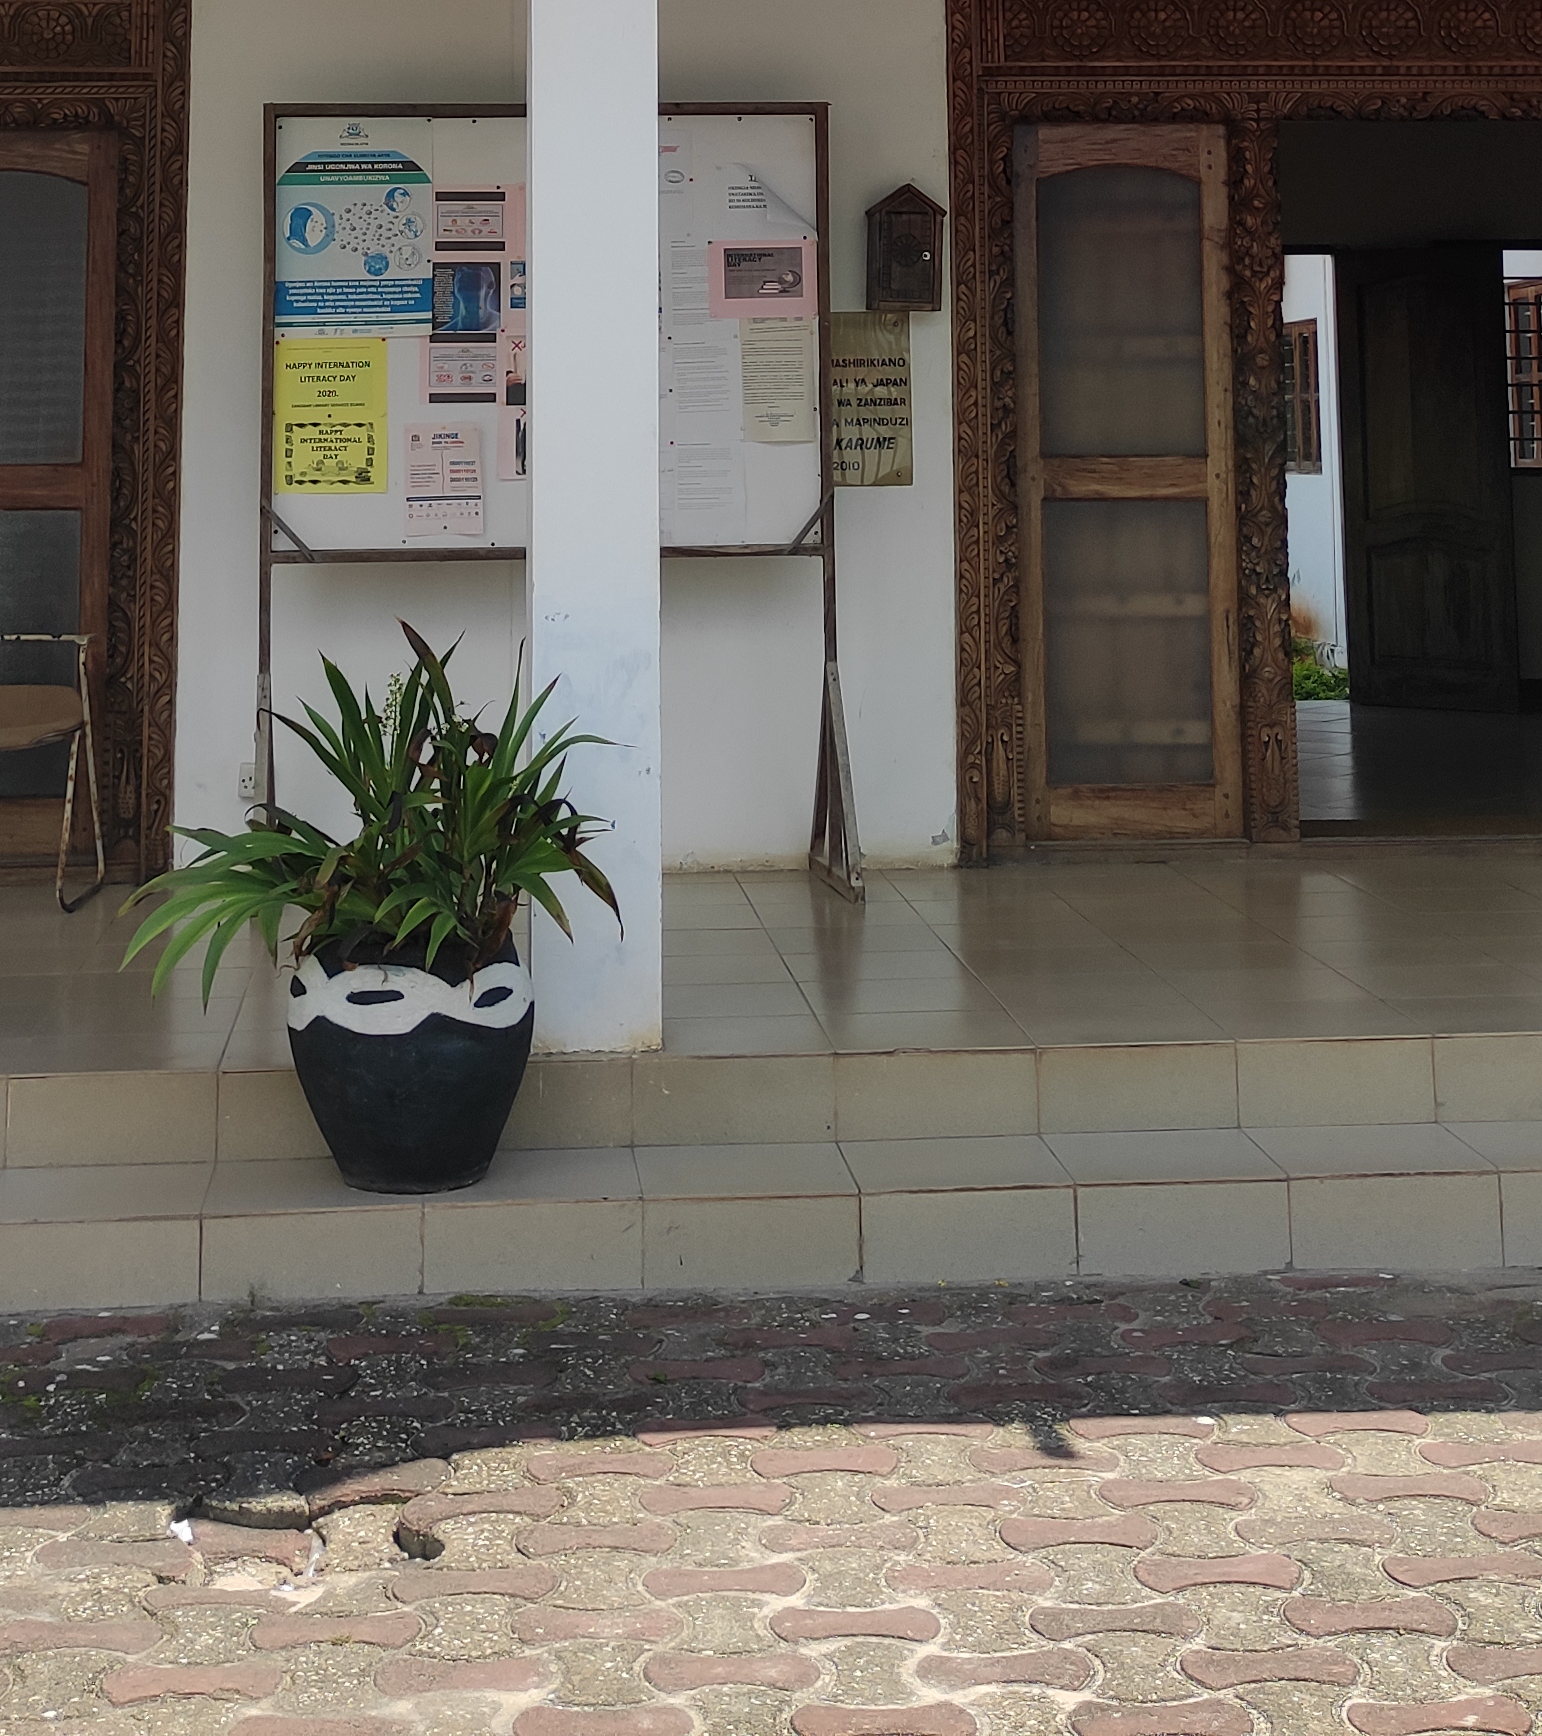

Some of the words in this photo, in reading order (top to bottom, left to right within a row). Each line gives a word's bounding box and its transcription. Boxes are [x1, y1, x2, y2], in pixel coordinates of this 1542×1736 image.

[831, 357, 905, 368] ASHIRIKIANO
[853, 377, 867, 387] YA
[871, 376, 907, 387] JAPAN
[836, 397, 852, 407] WA
[856, 396, 906, 407] ZANZIBAR
[844, 416, 908, 427] MAPINDUZI
[833, 436, 896, 450] KARUME
[832, 460, 860, 471] 2010
